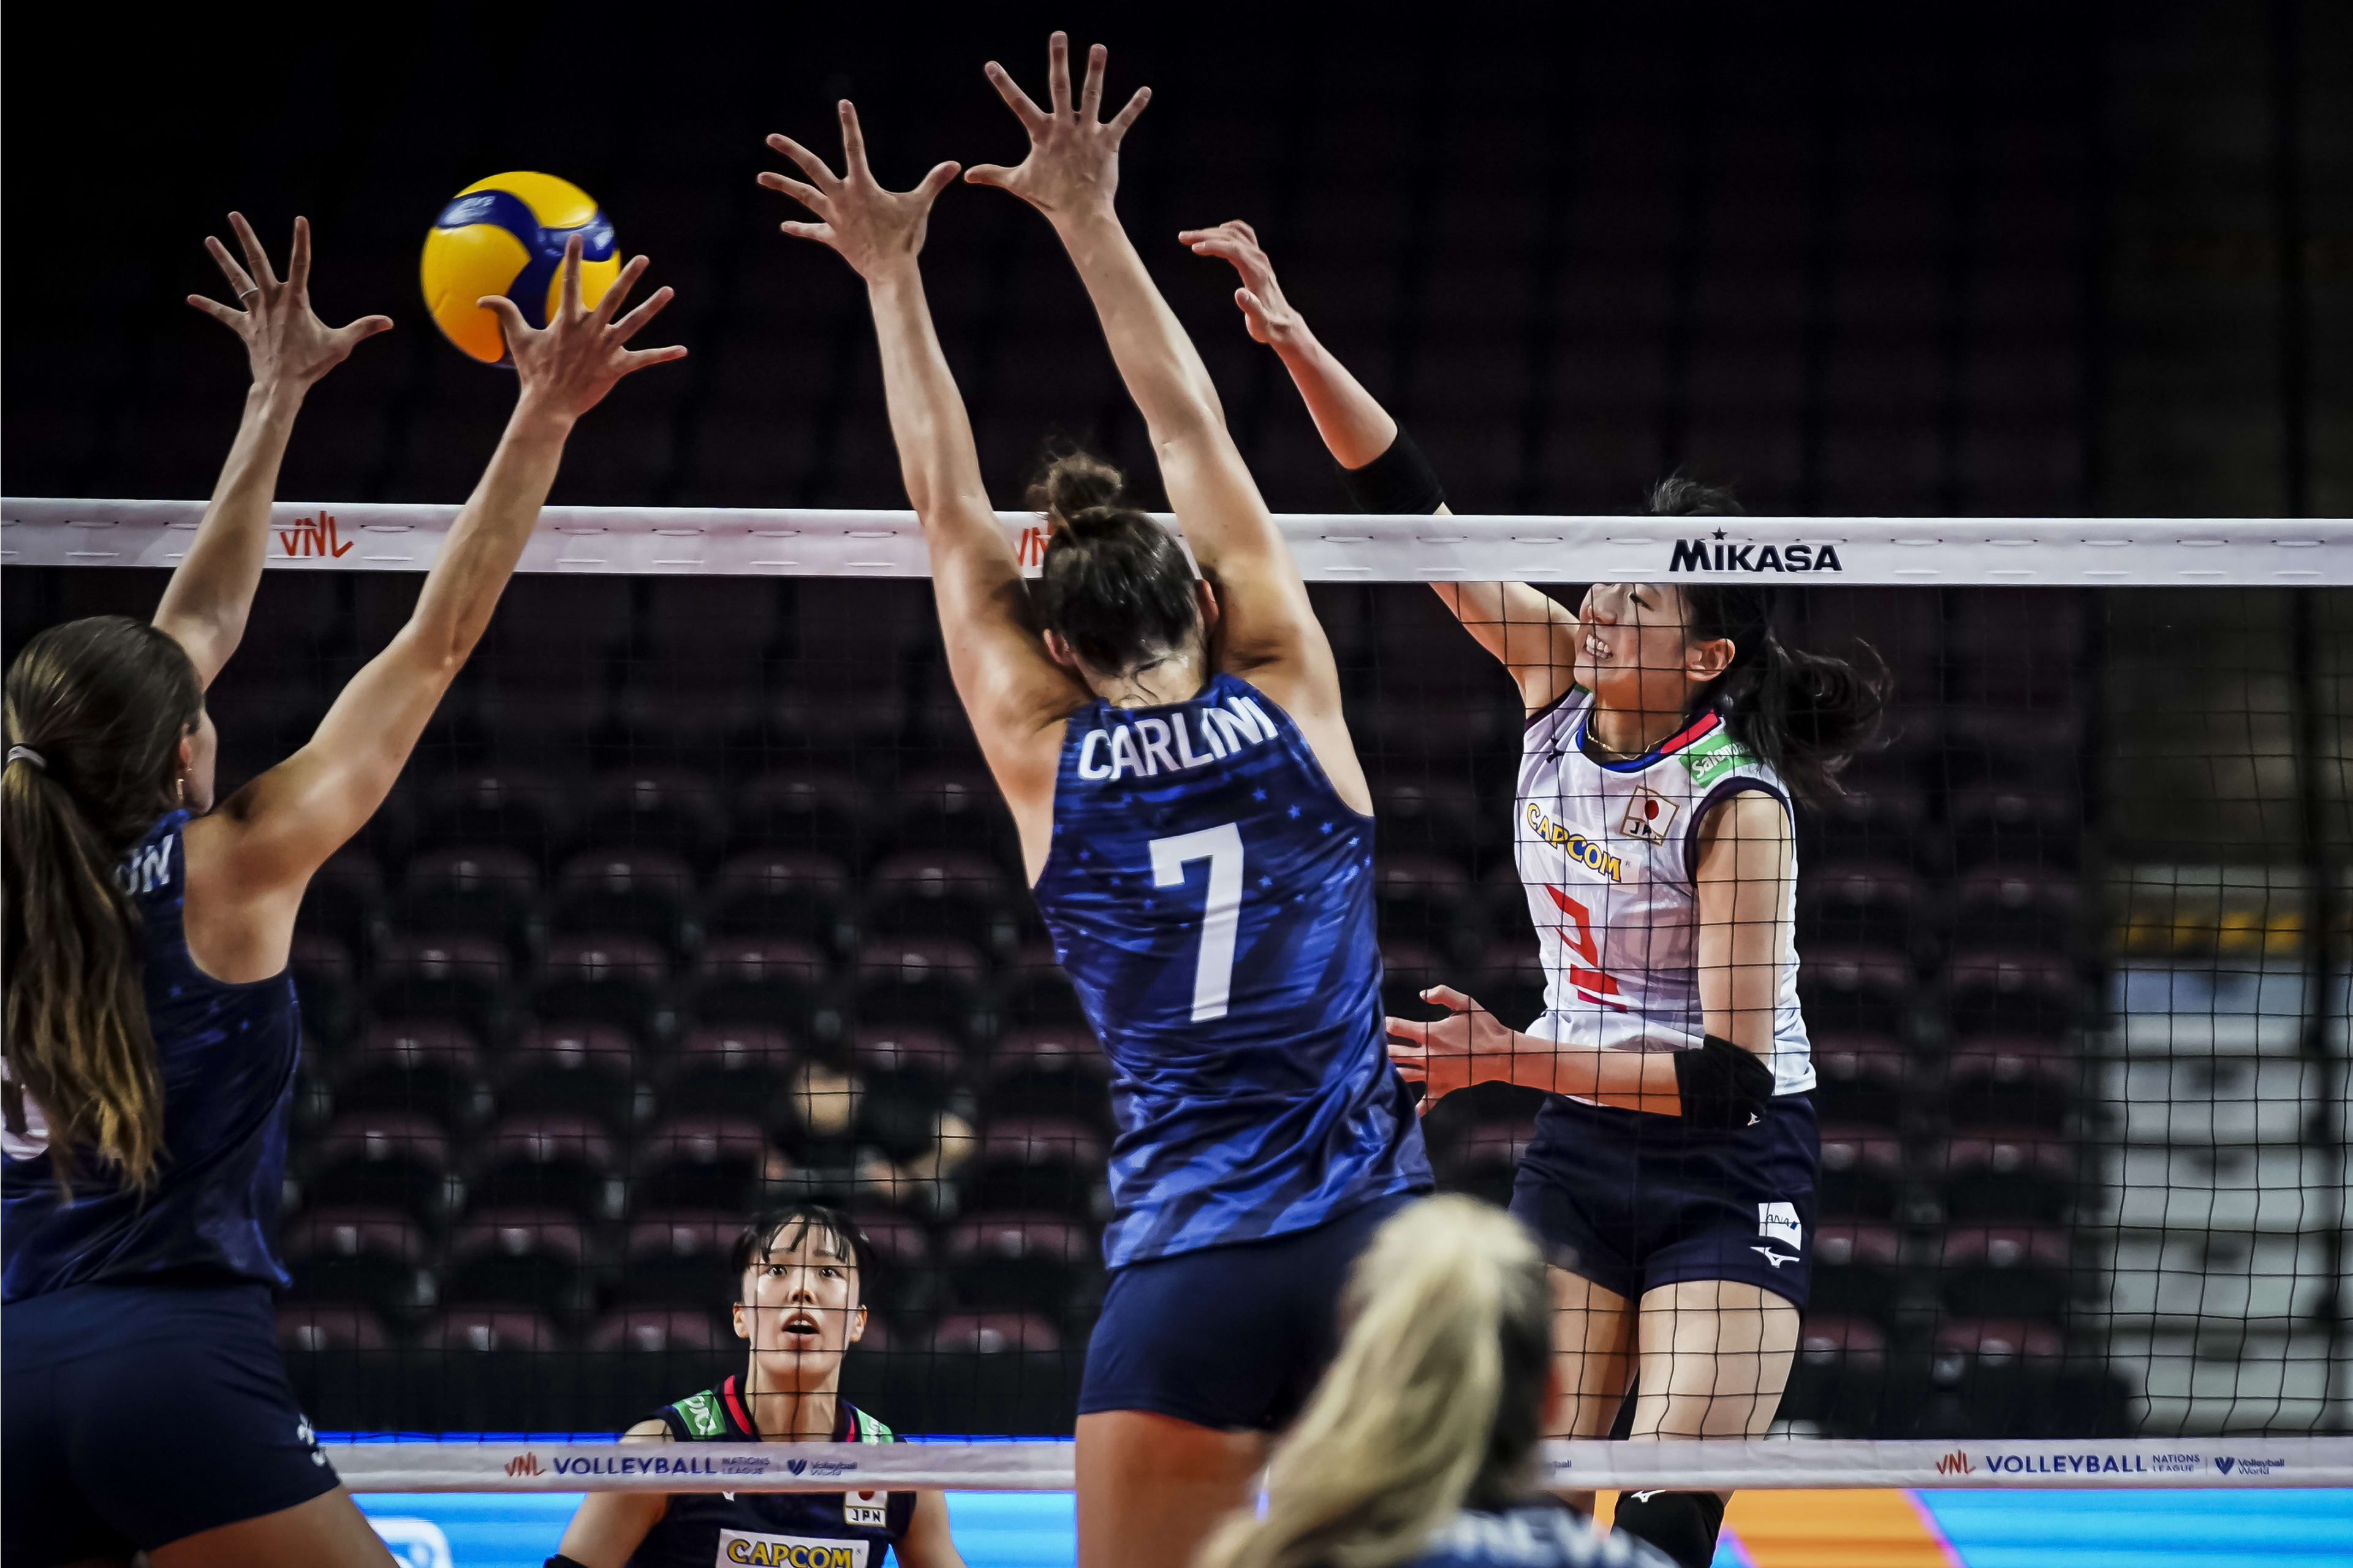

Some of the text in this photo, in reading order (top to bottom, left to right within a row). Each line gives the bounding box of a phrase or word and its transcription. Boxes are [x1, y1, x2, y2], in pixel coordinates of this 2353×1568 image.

[280, 510, 354, 558] VNL
[1669, 538, 1843, 573] MIKASA
[1077, 697, 1279, 780] CARLINI
[1527, 803, 1622, 883] CAPCOM
[1148, 822, 1244, 1023] 7
[553, 1456, 717, 1475] VOLLEYBALL
[1936, 1449, 2148, 1475] VNL VOLLEYBALL
[2153, 1454, 2201, 1464] NATIONS
[2238, 1458, 2285, 1468] Volleyball
[852, 1509, 881, 1523] JPN
[727, 1538, 853, 1568] CAPCOM
